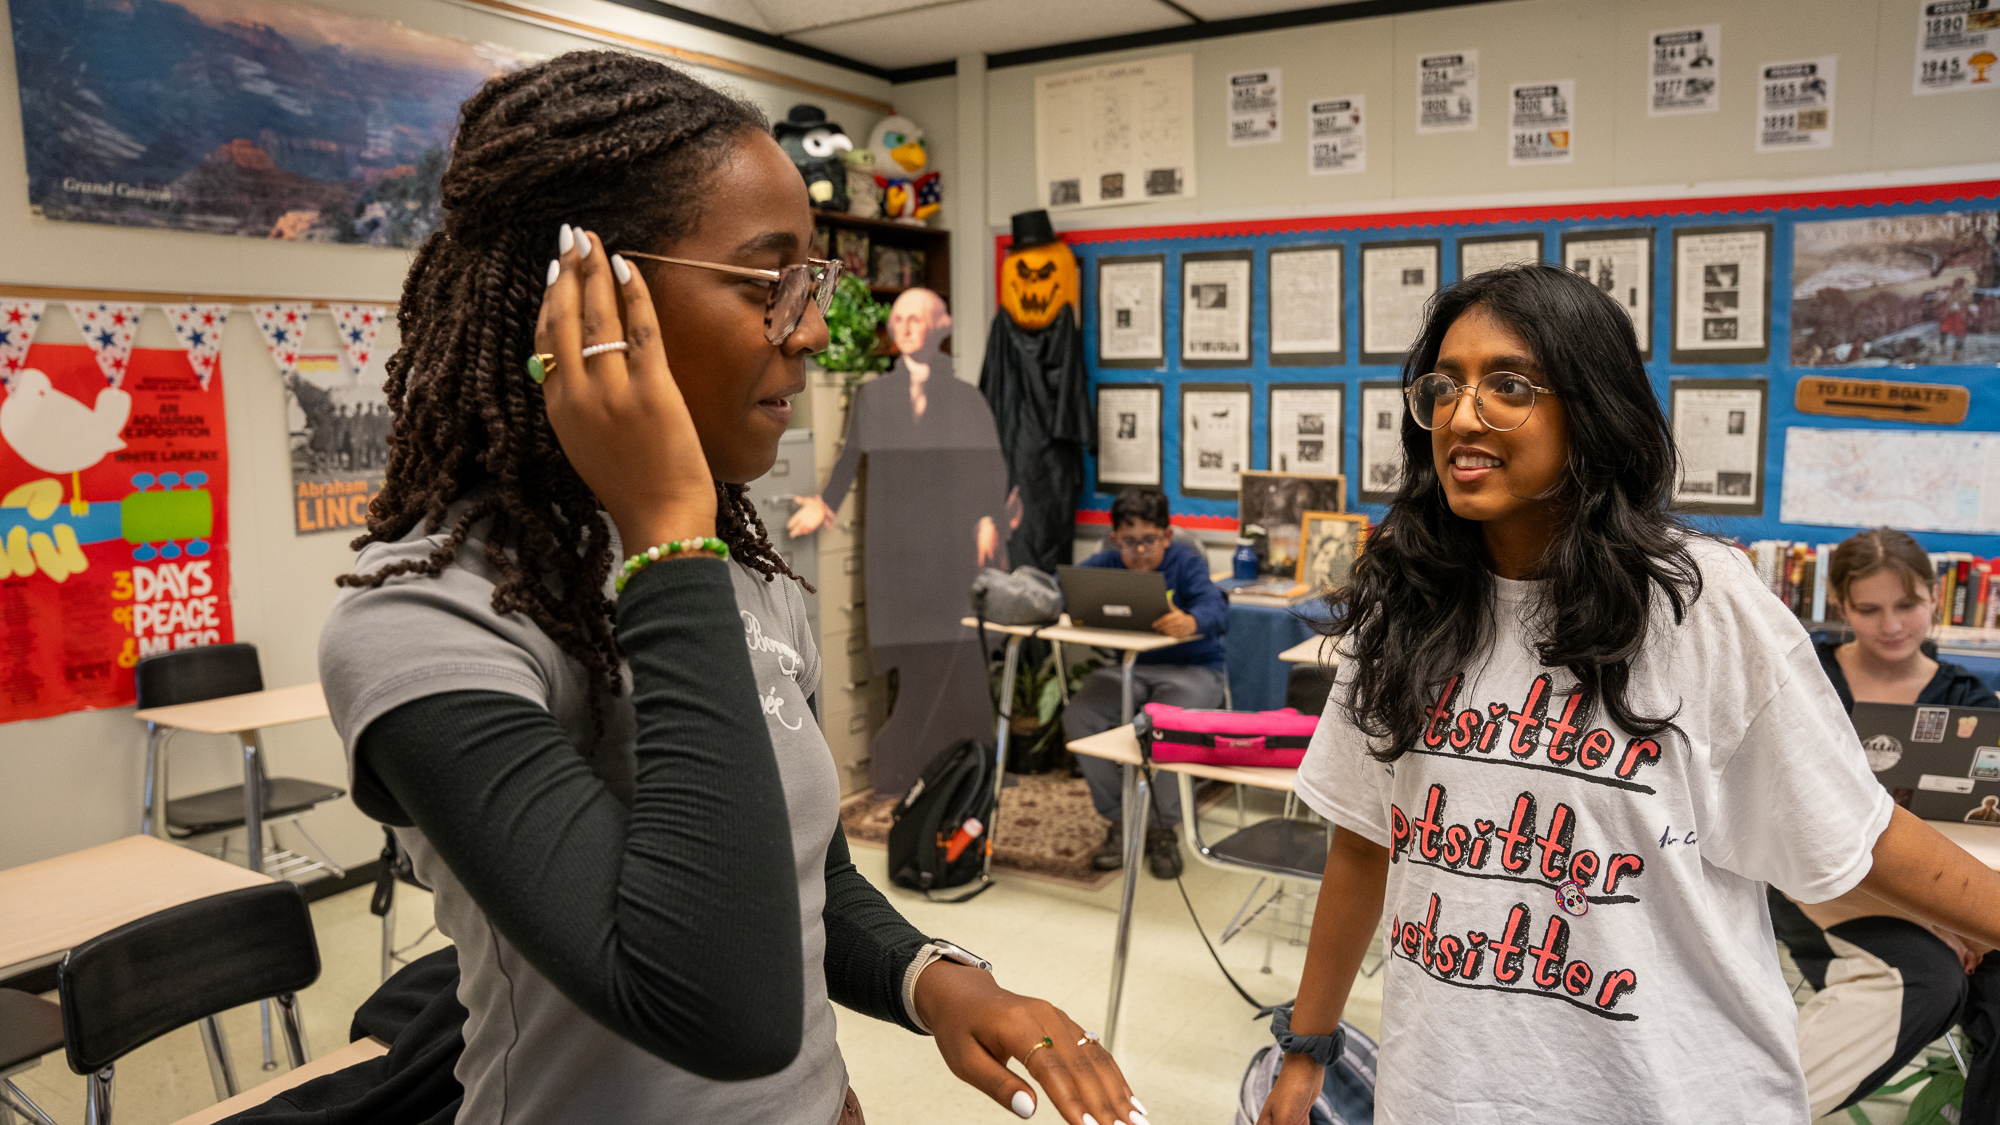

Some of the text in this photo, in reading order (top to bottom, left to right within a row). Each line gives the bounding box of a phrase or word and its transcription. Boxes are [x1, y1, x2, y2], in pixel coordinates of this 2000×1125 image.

[1926, 16, 1963, 35] 1890
[1922, 58, 1960, 76] 1945
[63, 177, 171, 203] Grand Canyon
[1817, 381, 1948, 403] TO LIFE BOATS
[132, 414, 205, 425] AQUARIAN
[124, 427, 211, 438] EXPOSITION
[297, 479, 368, 498] Abraham
[111, 561, 213, 602] 3 DAYS
[133, 595, 220, 637] PEACE
[1417, 671, 1662, 781] tsitter
[1391, 782, 1645, 895] ptsitter
